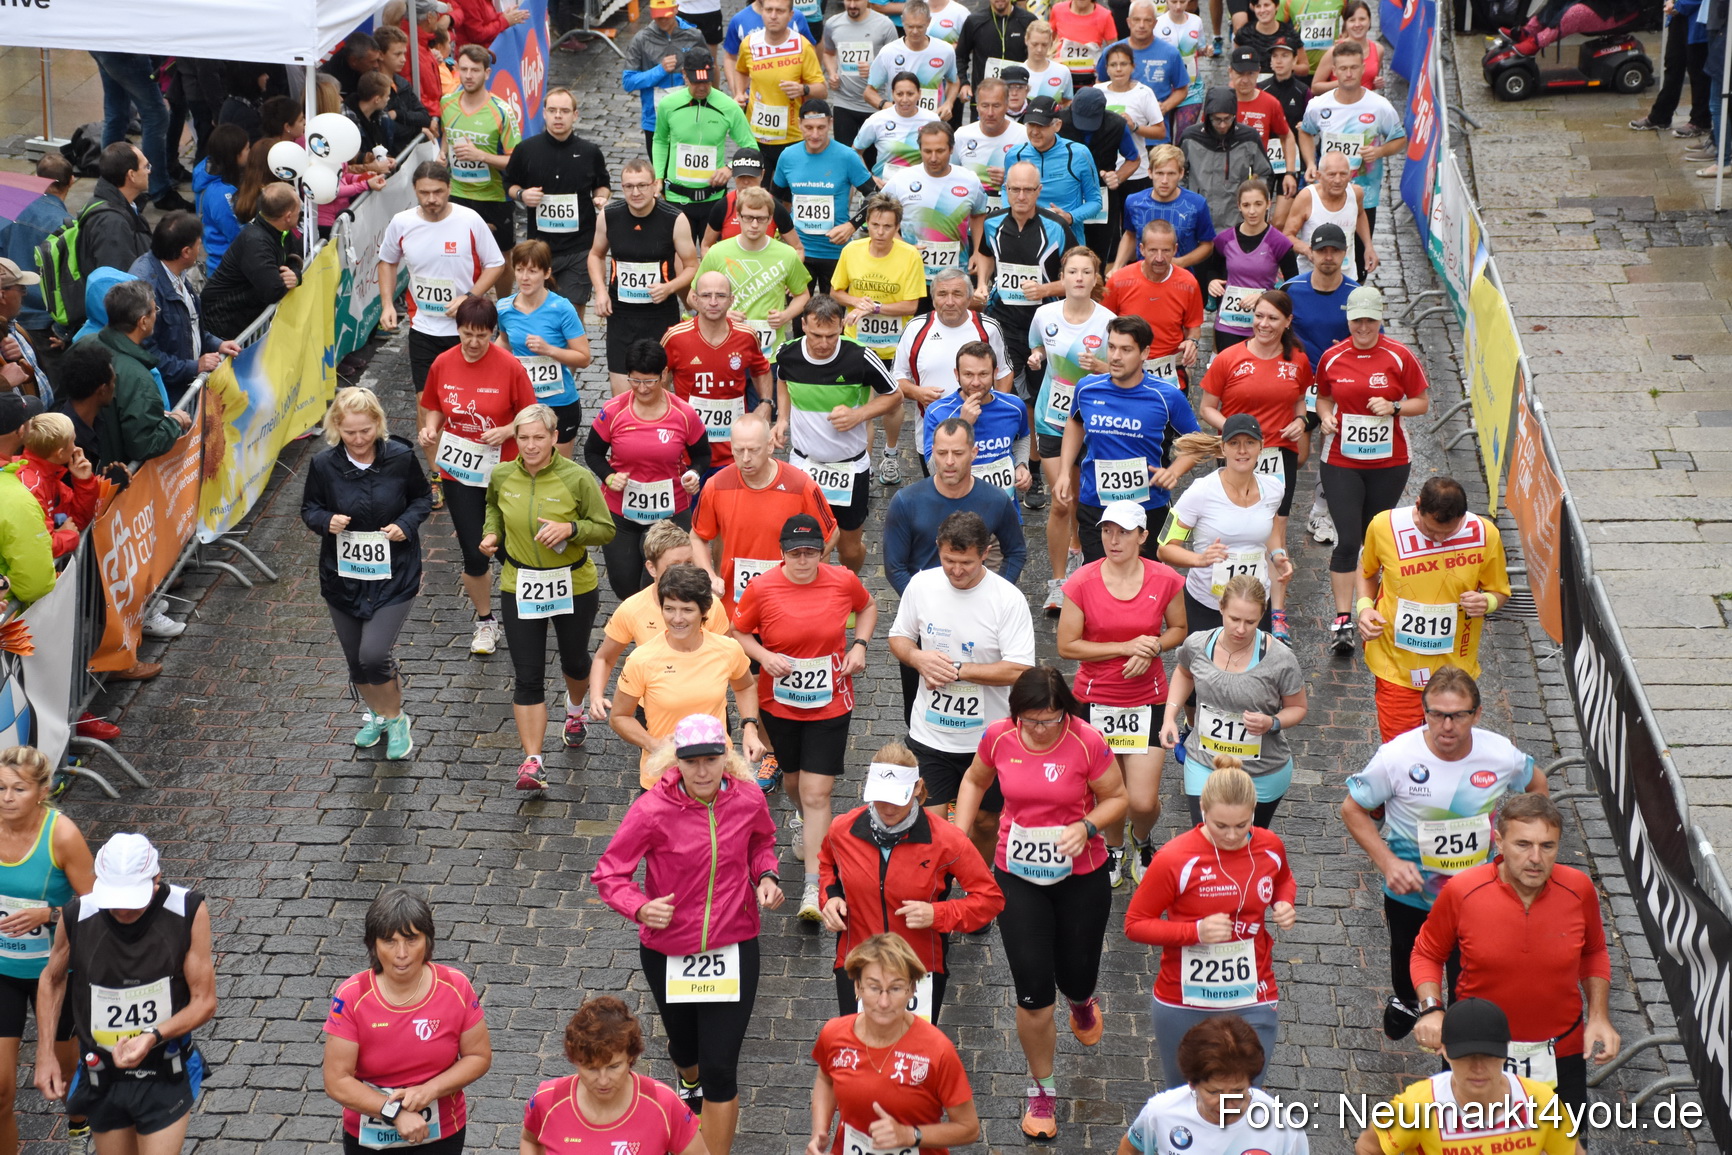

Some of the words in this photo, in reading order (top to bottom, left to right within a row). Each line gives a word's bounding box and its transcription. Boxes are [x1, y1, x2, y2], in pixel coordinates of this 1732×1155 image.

[1304, 26, 1332, 40] 2844
[842, 50, 870, 62] 2277
[1067, 46, 1088, 58] 212
[752, 62, 775, 71] MAX
[777, 56, 802, 67] BÖGL
[757, 112, 780, 128] 290
[684, 153, 709, 168] 608
[733, 157, 760, 168] adidas
[791, 180, 834, 189] www.hasit.de
[540, 203, 575, 219] 2665
[797, 204, 830, 220] 2489
[921, 251, 956, 265] 2127
[620, 271, 656, 287] 2647
[416, 284, 452, 302] 2703
[626, 290, 650, 298] Thomas
[425, 303, 444, 311] Marco
[861, 318, 899, 335] 3094
[1231, 315, 1251, 323] Louisa
[1090, 414, 1142, 430] SYSCAD
[1347, 426, 1389, 443] 2652
[442, 444, 484, 470] 2797
[1358, 446, 1377, 454] Karin
[447, 467, 471, 480] Angela
[808, 467, 850, 488] 3068
[1101, 470, 1144, 489] 2395
[627, 491, 670, 509] 2916
[1111, 492, 1135, 500] Fabian
[637, 511, 660, 521] Margit
[342, 541, 385, 562] 2498
[350, 564, 376, 574] Monika
[1401, 560, 1439, 577] MAX
[1445, 553, 1485, 569] BÖGL
[523, 580, 567, 600] 2215
[535, 603, 555, 612] Petra
[1401, 614, 1452, 635] 2819
[1407, 637, 1442, 648] Christian
[780, 669, 827, 690] 2322
[788, 692, 817, 702] Monika
[931, 690, 979, 716] 2742
[939, 717, 966, 728] Hubert
[1103, 714, 1139, 733] 348
[1210, 718, 1247, 742] 217
[1107, 738, 1135, 747] Martina
[1213, 743, 1243, 754] Kerstin
[1434, 832, 1479, 856] 254
[1012, 840, 1066, 864] 2255
[1440, 858, 1475, 869] Werner
[1023, 866, 1055, 878] Birgitta
[1199, 884, 1237, 893] SPORTNANKA
[682, 954, 726, 977] 225
[1190, 957, 1250, 983] 2256
[690, 983, 716, 993] Petra
[1201, 987, 1239, 998] Theresa
[107, 1000, 158, 1028] 243
[1490, 1136, 1537, 1154] BÖGL
